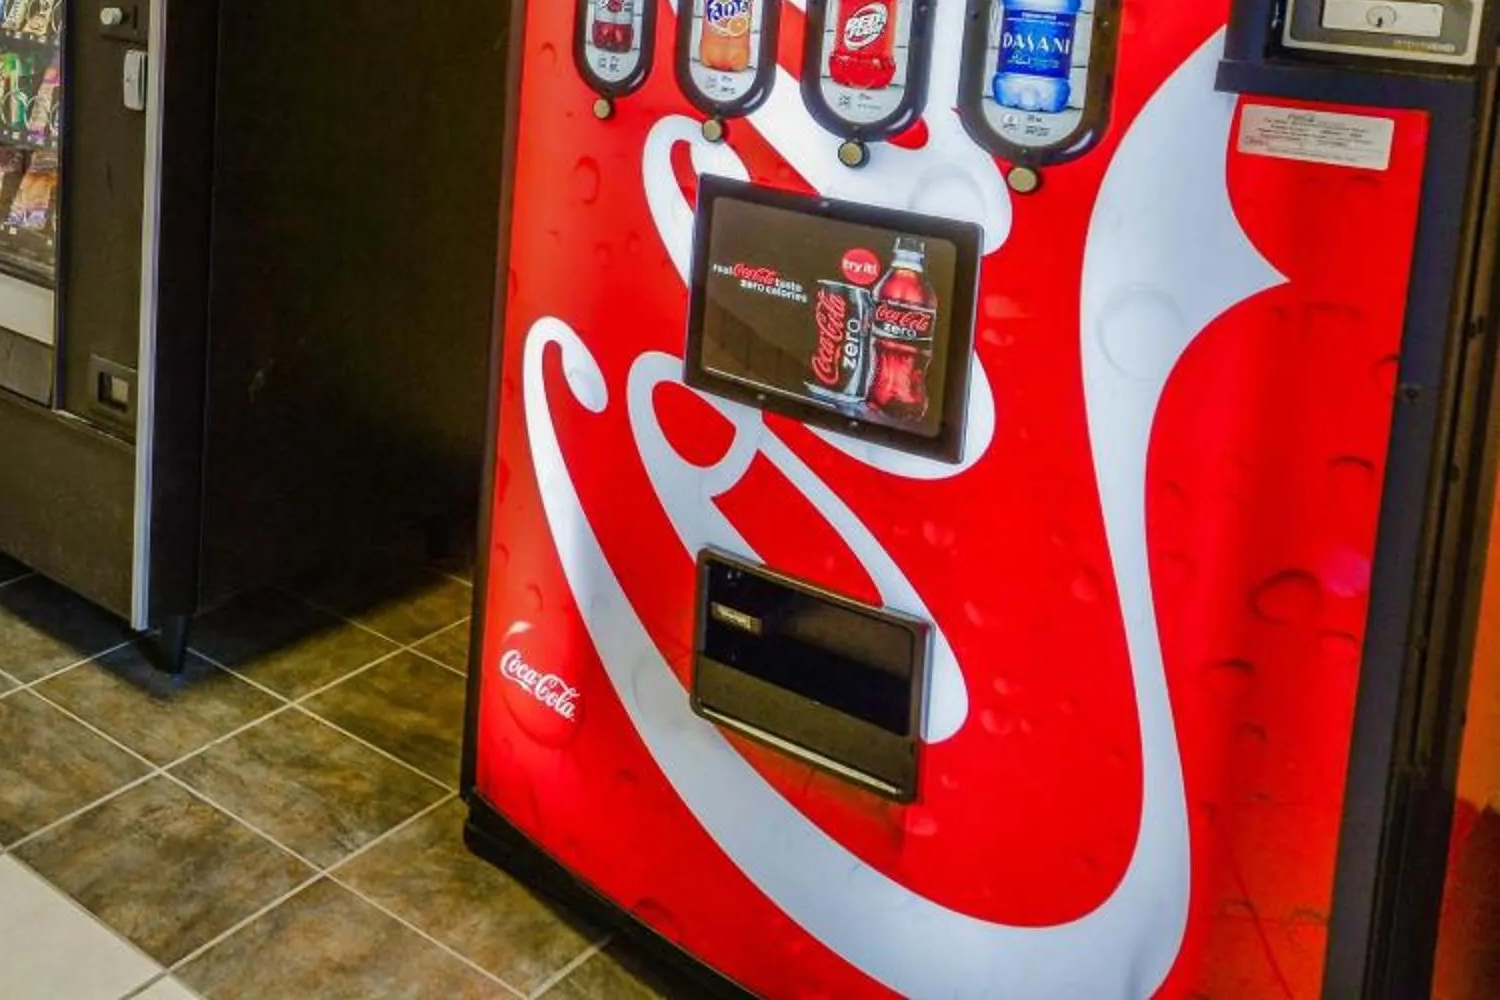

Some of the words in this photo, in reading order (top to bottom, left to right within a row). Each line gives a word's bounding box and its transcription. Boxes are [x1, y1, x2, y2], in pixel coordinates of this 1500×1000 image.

[1002, 31, 1071, 56] DASANI
[713, 263, 733, 275] real
[775, 277, 804, 293] taste
[841, 257, 863, 273] try
[739, 279, 765, 293] zero
[765, 285, 808, 303] calories
[875, 303, 931, 332] Coca-Cola
[882, 322, 917, 339] zero
[812, 290, 846, 385] Coca-Cola
[843, 318, 861, 370] zero
[500, 648, 581, 721] Coca-Cola
